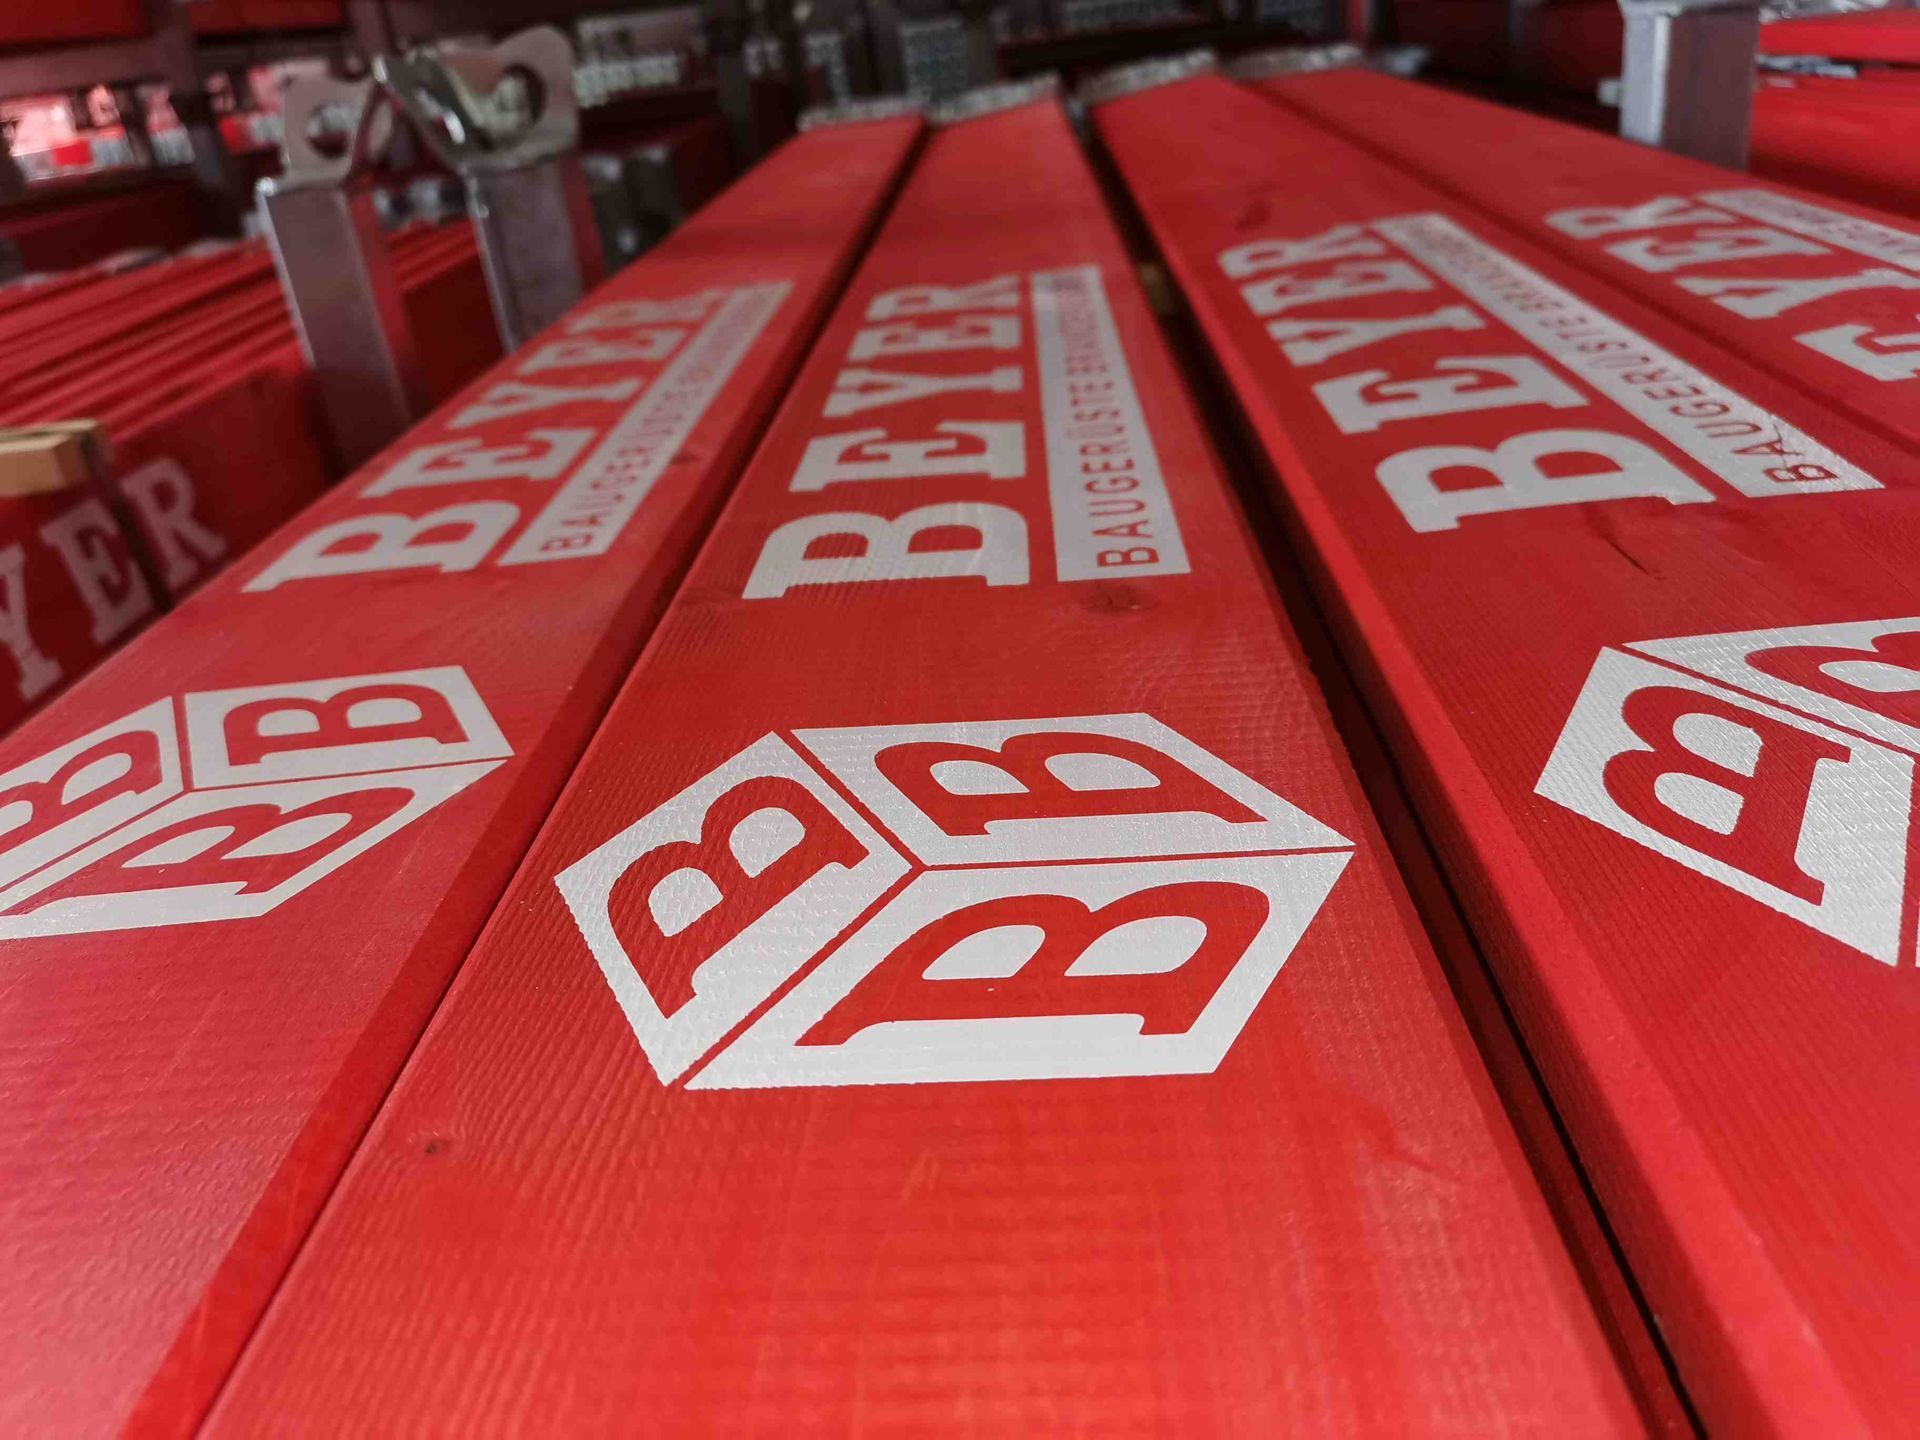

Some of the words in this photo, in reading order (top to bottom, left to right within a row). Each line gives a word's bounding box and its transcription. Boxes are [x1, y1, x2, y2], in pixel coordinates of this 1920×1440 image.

[241, 286, 728, 593] BEYER
[741, 275, 1029, 599] BEYER
[1217, 224, 1716, 533] BEYER
[222, 684, 470, 767] B
[875, 732, 1268, 836] B
[1603, 686, 1852, 906] B
[607, 775, 870, 1019] B
[795, 881, 1271, 1047] B
